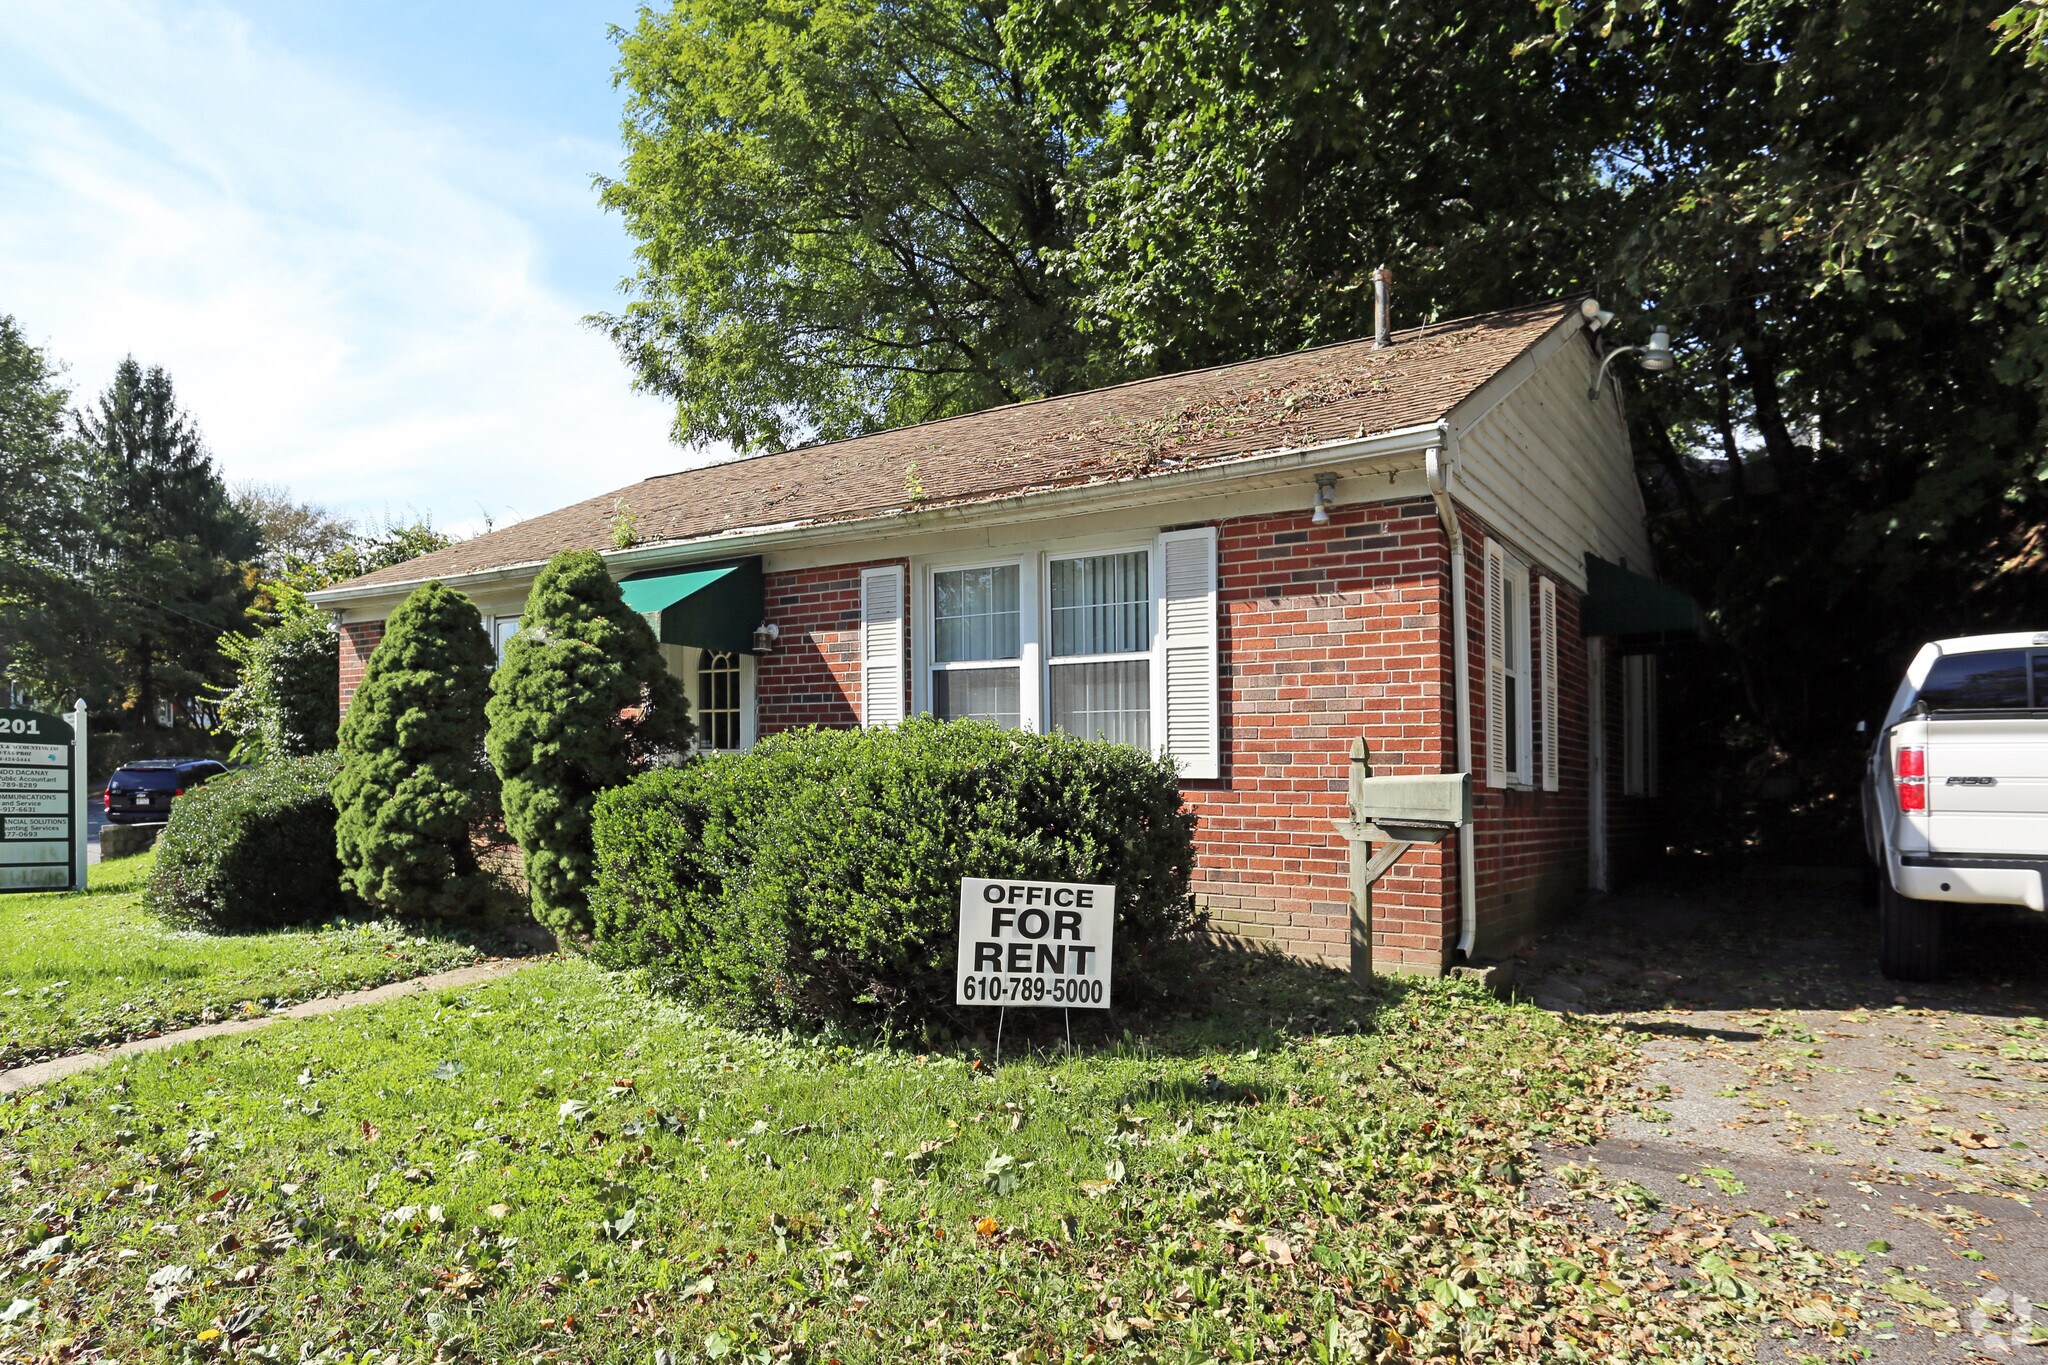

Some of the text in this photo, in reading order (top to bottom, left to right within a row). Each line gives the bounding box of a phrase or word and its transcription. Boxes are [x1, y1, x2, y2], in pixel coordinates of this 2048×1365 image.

[983, 884, 1094, 909] OFFICE
[990, 907, 1082, 941] FOR
[973, 941, 1096, 976] RENT
[963, 976, 1103, 1004] 610-789-5000
